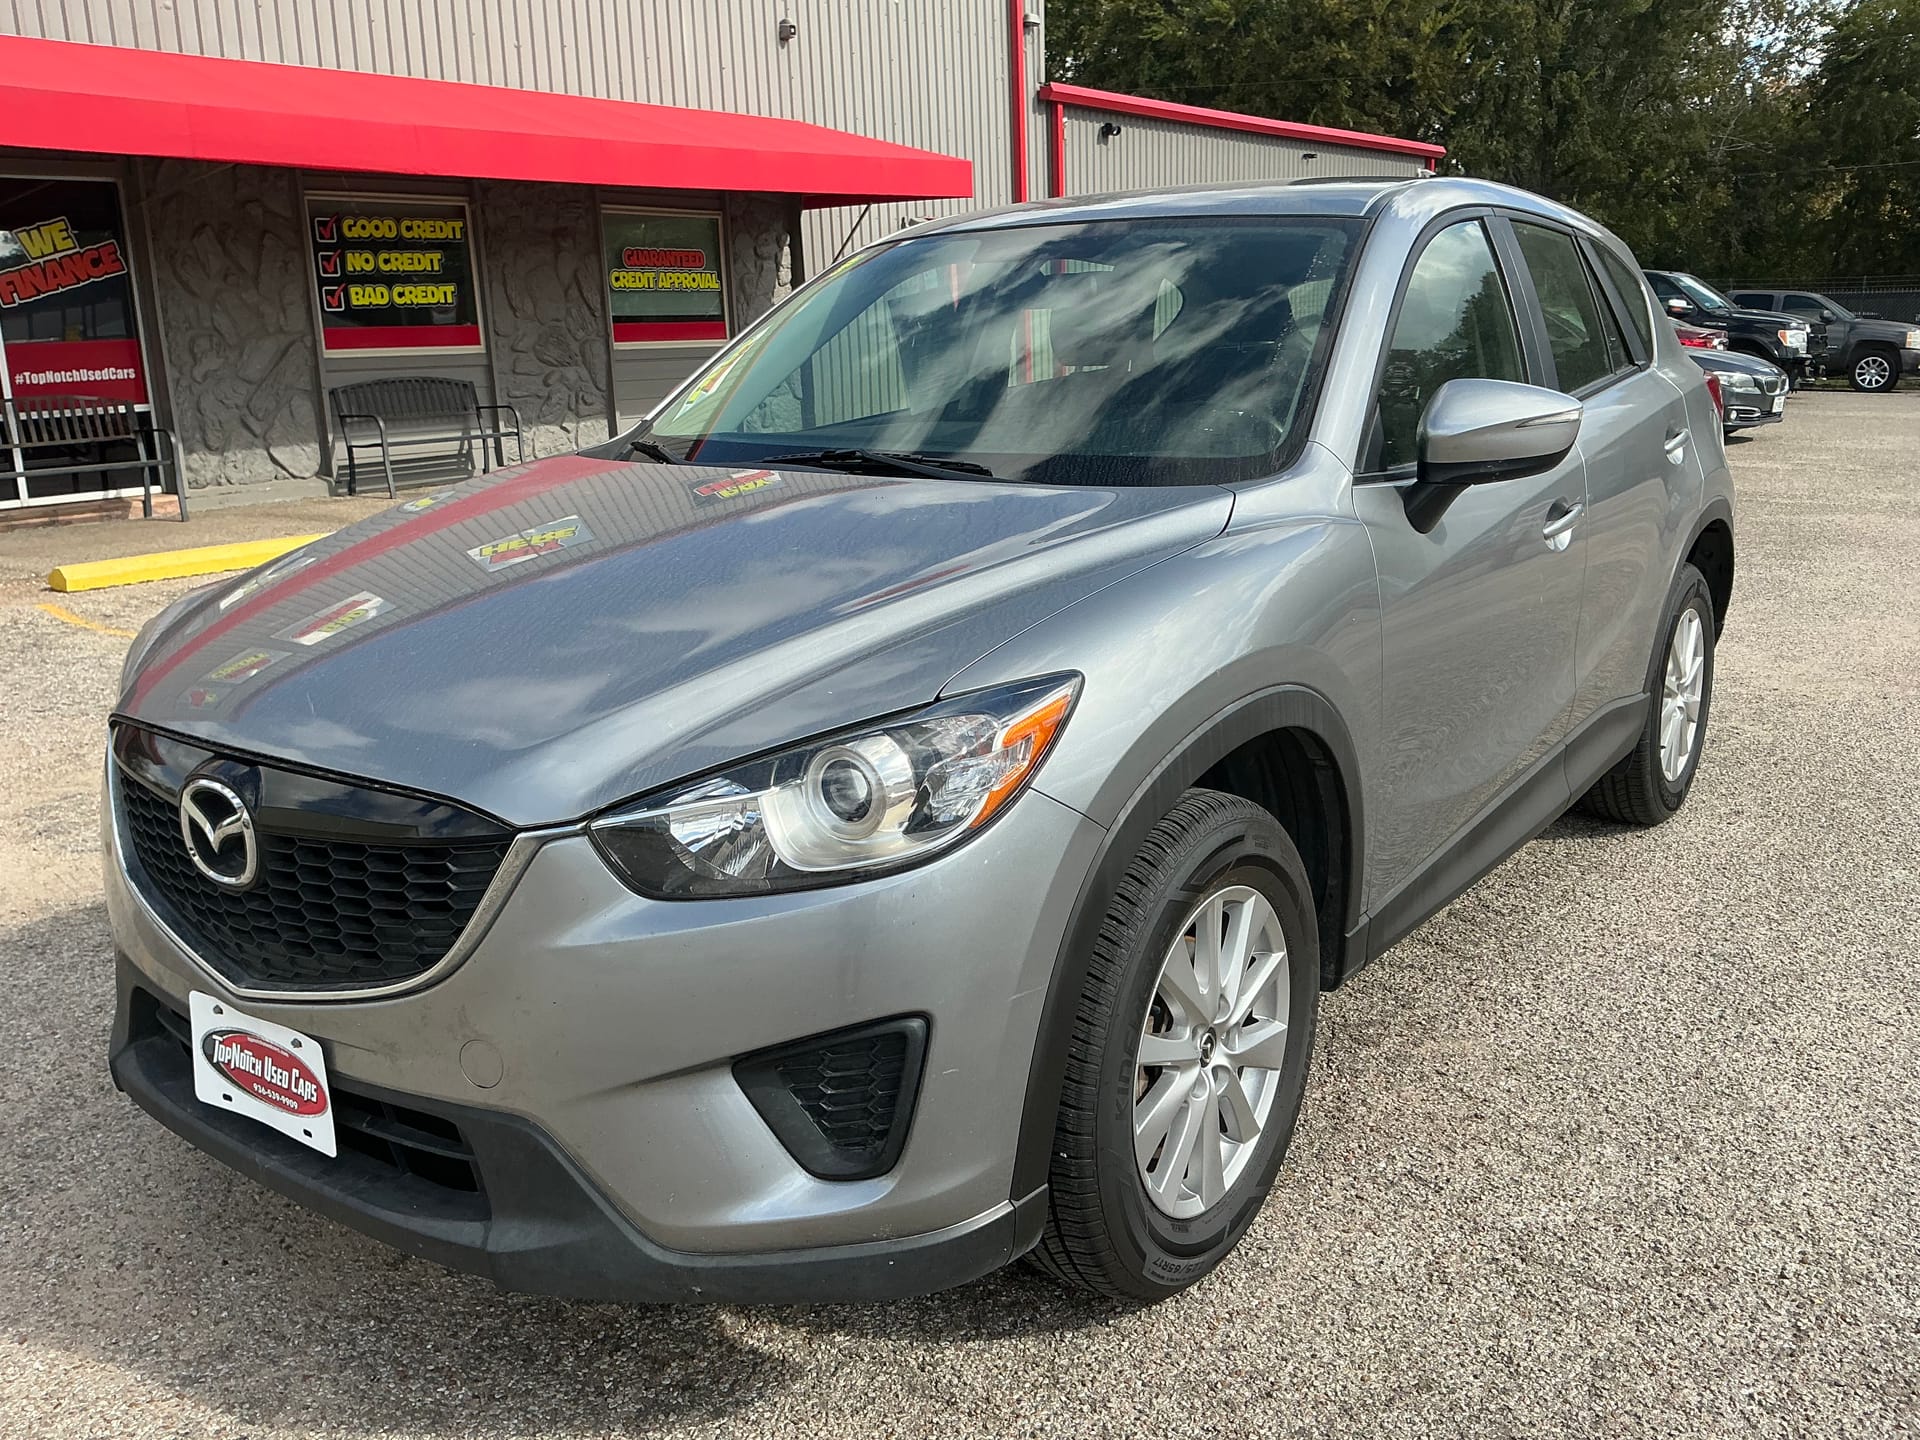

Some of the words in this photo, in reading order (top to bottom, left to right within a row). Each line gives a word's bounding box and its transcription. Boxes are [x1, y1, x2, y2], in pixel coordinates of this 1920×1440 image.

[15, 218, 77, 260] WE
[342, 218, 398, 239] GOOD
[400, 220, 464, 240] CREDIT
[346, 252, 375, 272] NO
[378, 252, 442, 273] CREDIT
[623, 248, 705, 268] GUARANTEED
[0, 242, 126, 306] FINANCE
[611, 271, 656, 289] CREDIT
[658, 272, 720, 290] APPROVAL
[350, 286, 390, 306] BAD
[392, 285, 455, 305] CREDIT
[14, 367, 136, 386] #TopNotchUsedCars
